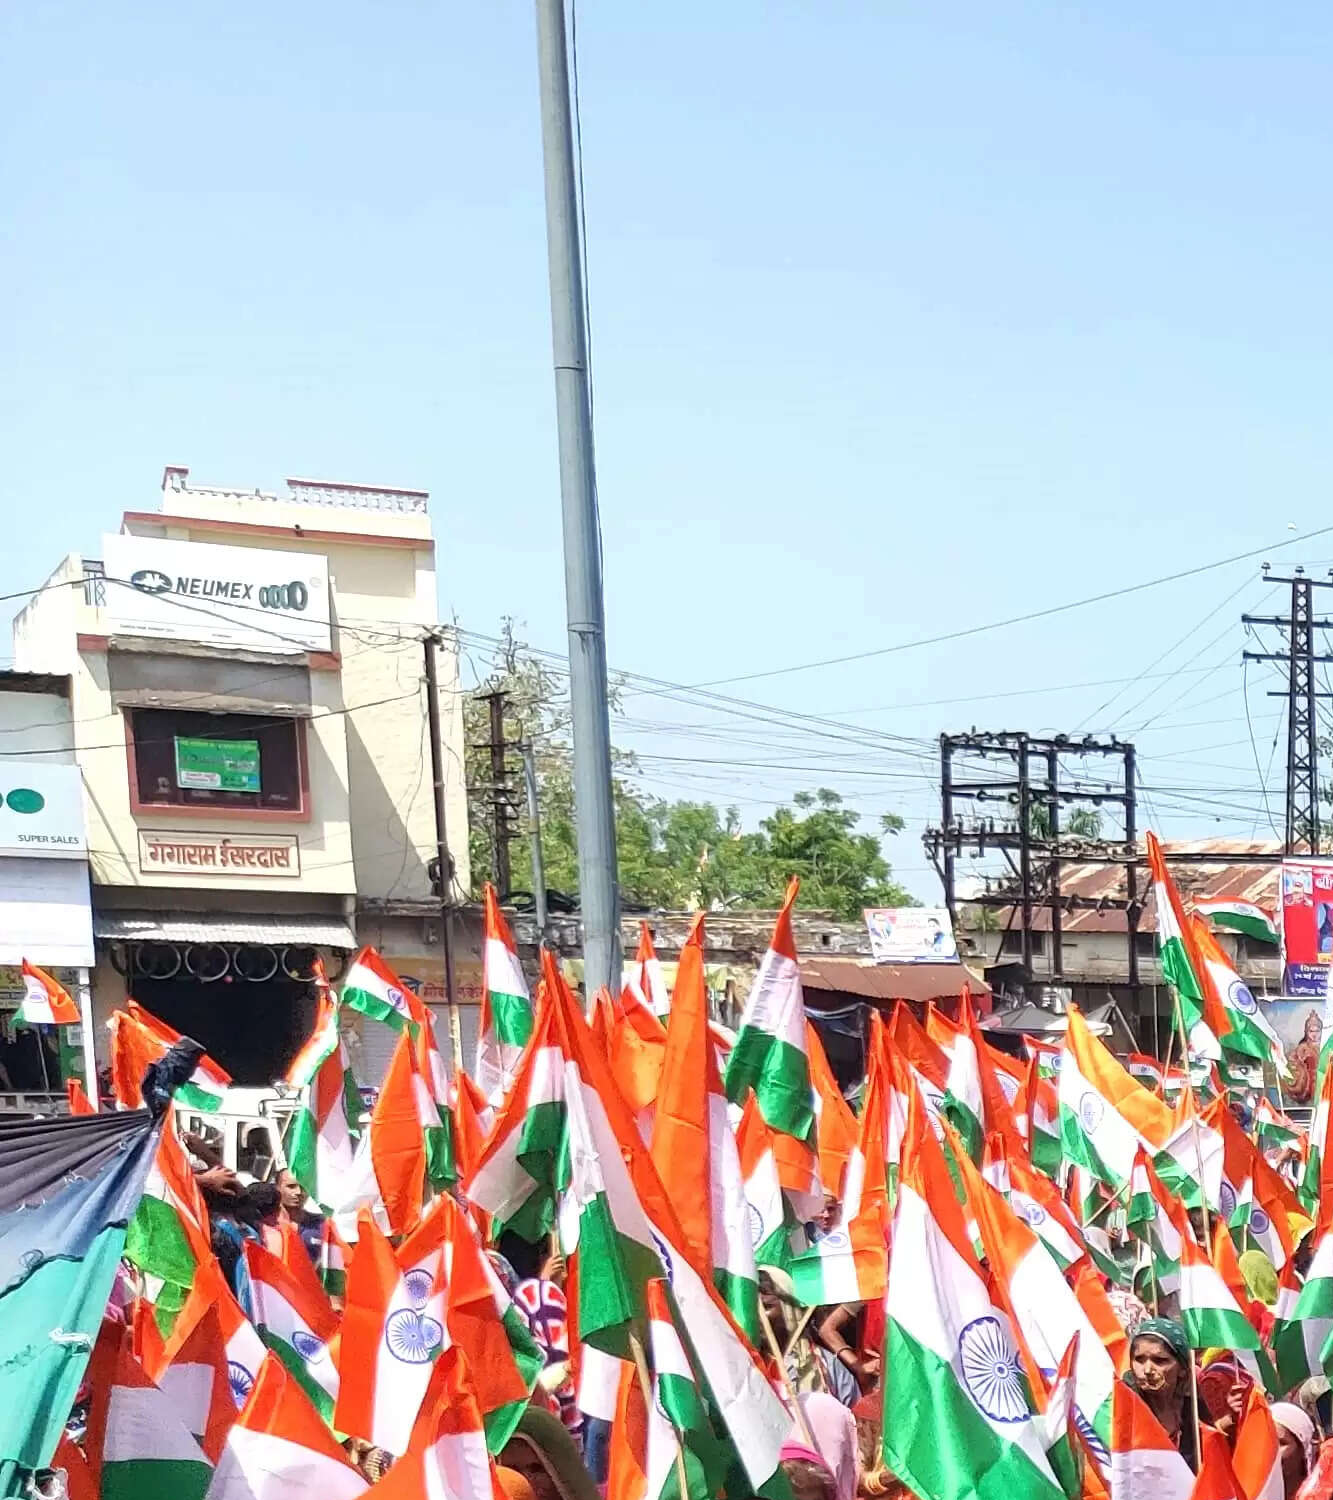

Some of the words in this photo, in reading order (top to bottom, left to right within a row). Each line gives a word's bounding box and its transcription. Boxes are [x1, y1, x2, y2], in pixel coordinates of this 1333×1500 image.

[175, 577, 253, 599] NEUMEX
[17, 834, 49, 843] SUPER
[50, 836, 80, 845] SALES
[148, 838, 217, 867] गंगाराम
